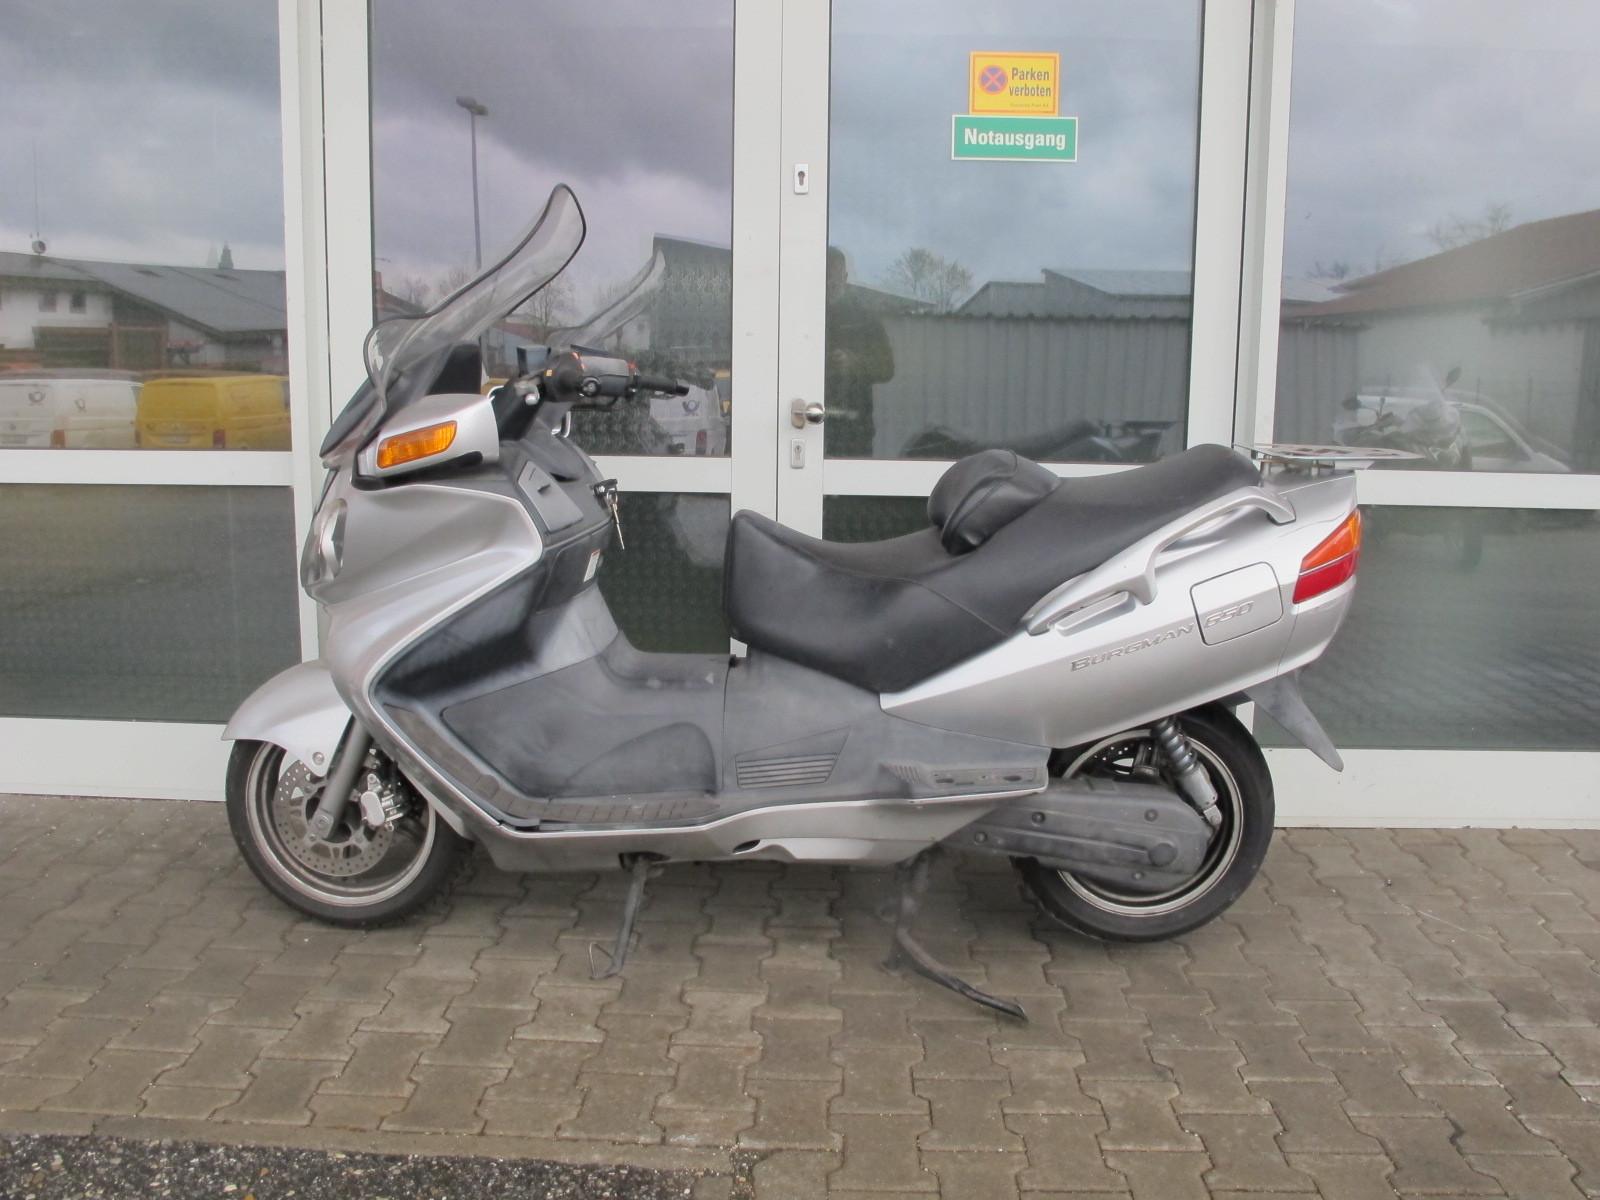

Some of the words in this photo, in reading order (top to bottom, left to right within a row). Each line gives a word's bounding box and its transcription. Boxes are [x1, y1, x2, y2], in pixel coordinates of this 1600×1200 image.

[1011, 67, 1050, 81] Parken
[1009, 84, 1051, 97] verboten
[964, 127, 1066, 150] Notausgang
[1071, 622, 1194, 672] BURGMAN
[1204, 600, 1254, 628] 650
